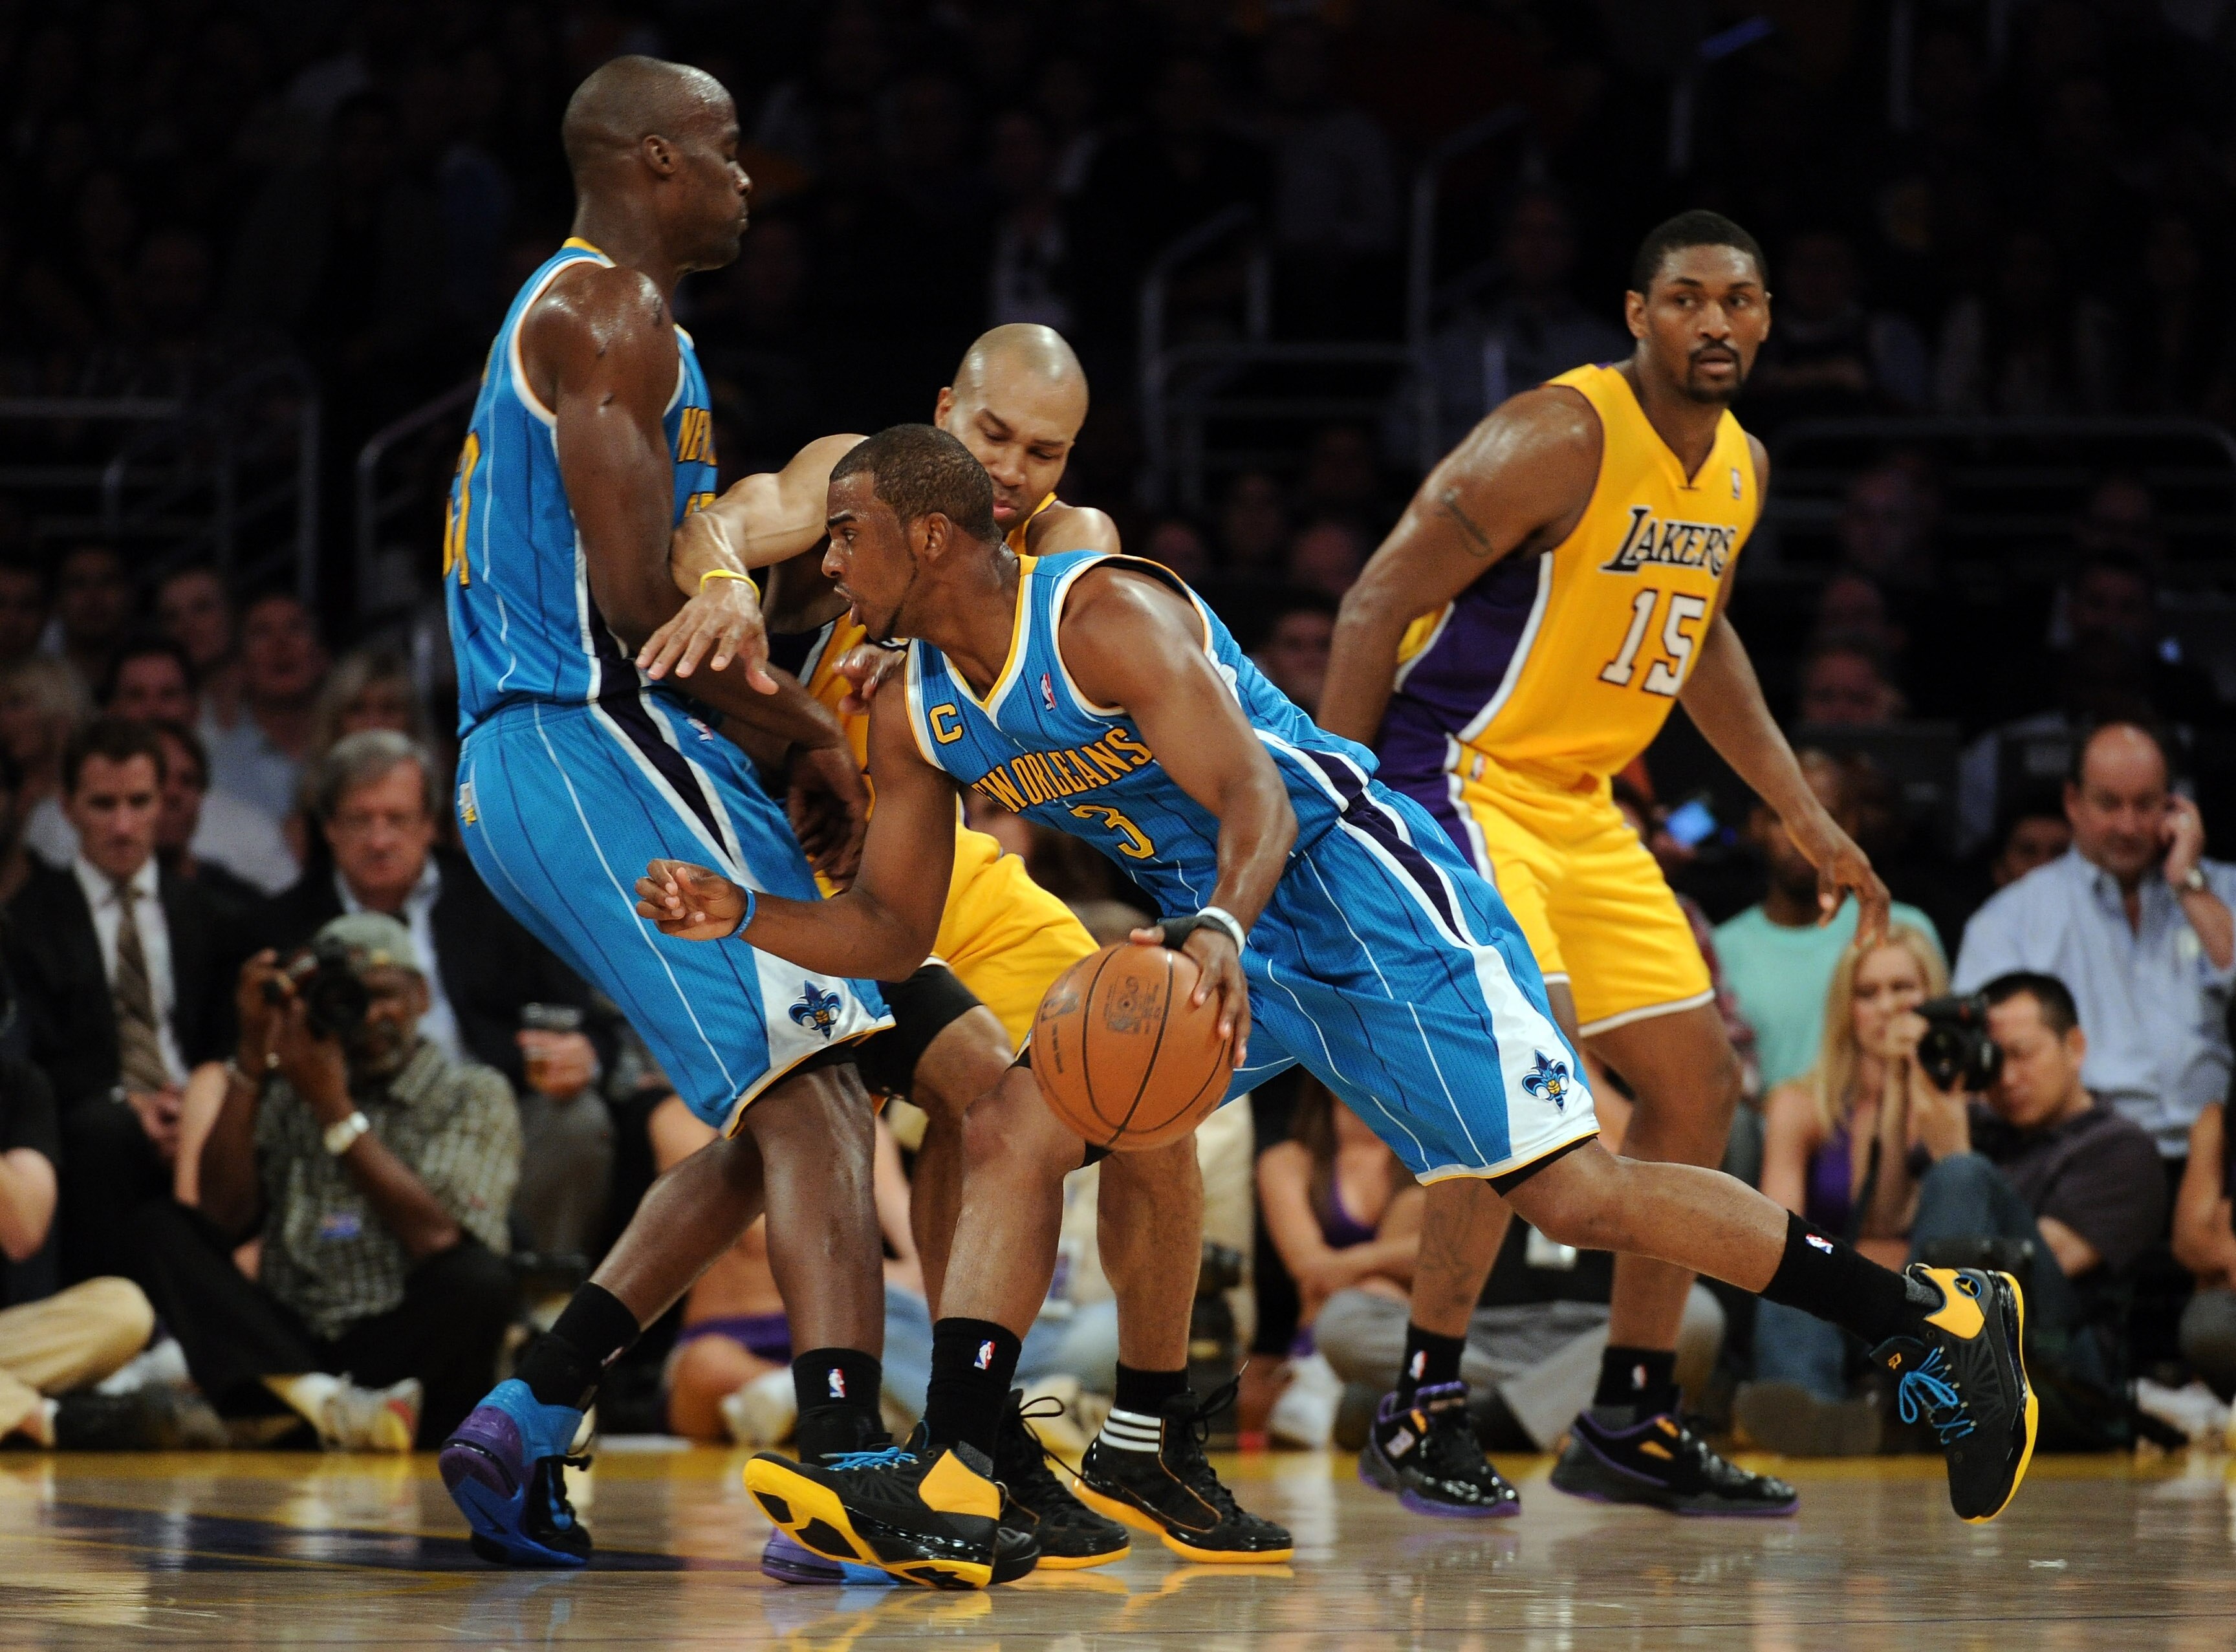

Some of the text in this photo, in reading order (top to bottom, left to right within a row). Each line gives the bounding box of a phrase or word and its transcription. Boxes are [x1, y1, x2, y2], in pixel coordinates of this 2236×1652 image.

[1598, 505, 1737, 581] LAKERS
[1598, 587, 1707, 697] 15
[929, 702, 964, 744] C
[1010, 726, 1154, 806] ORLEANS
[1069, 803, 1156, 860] 3
